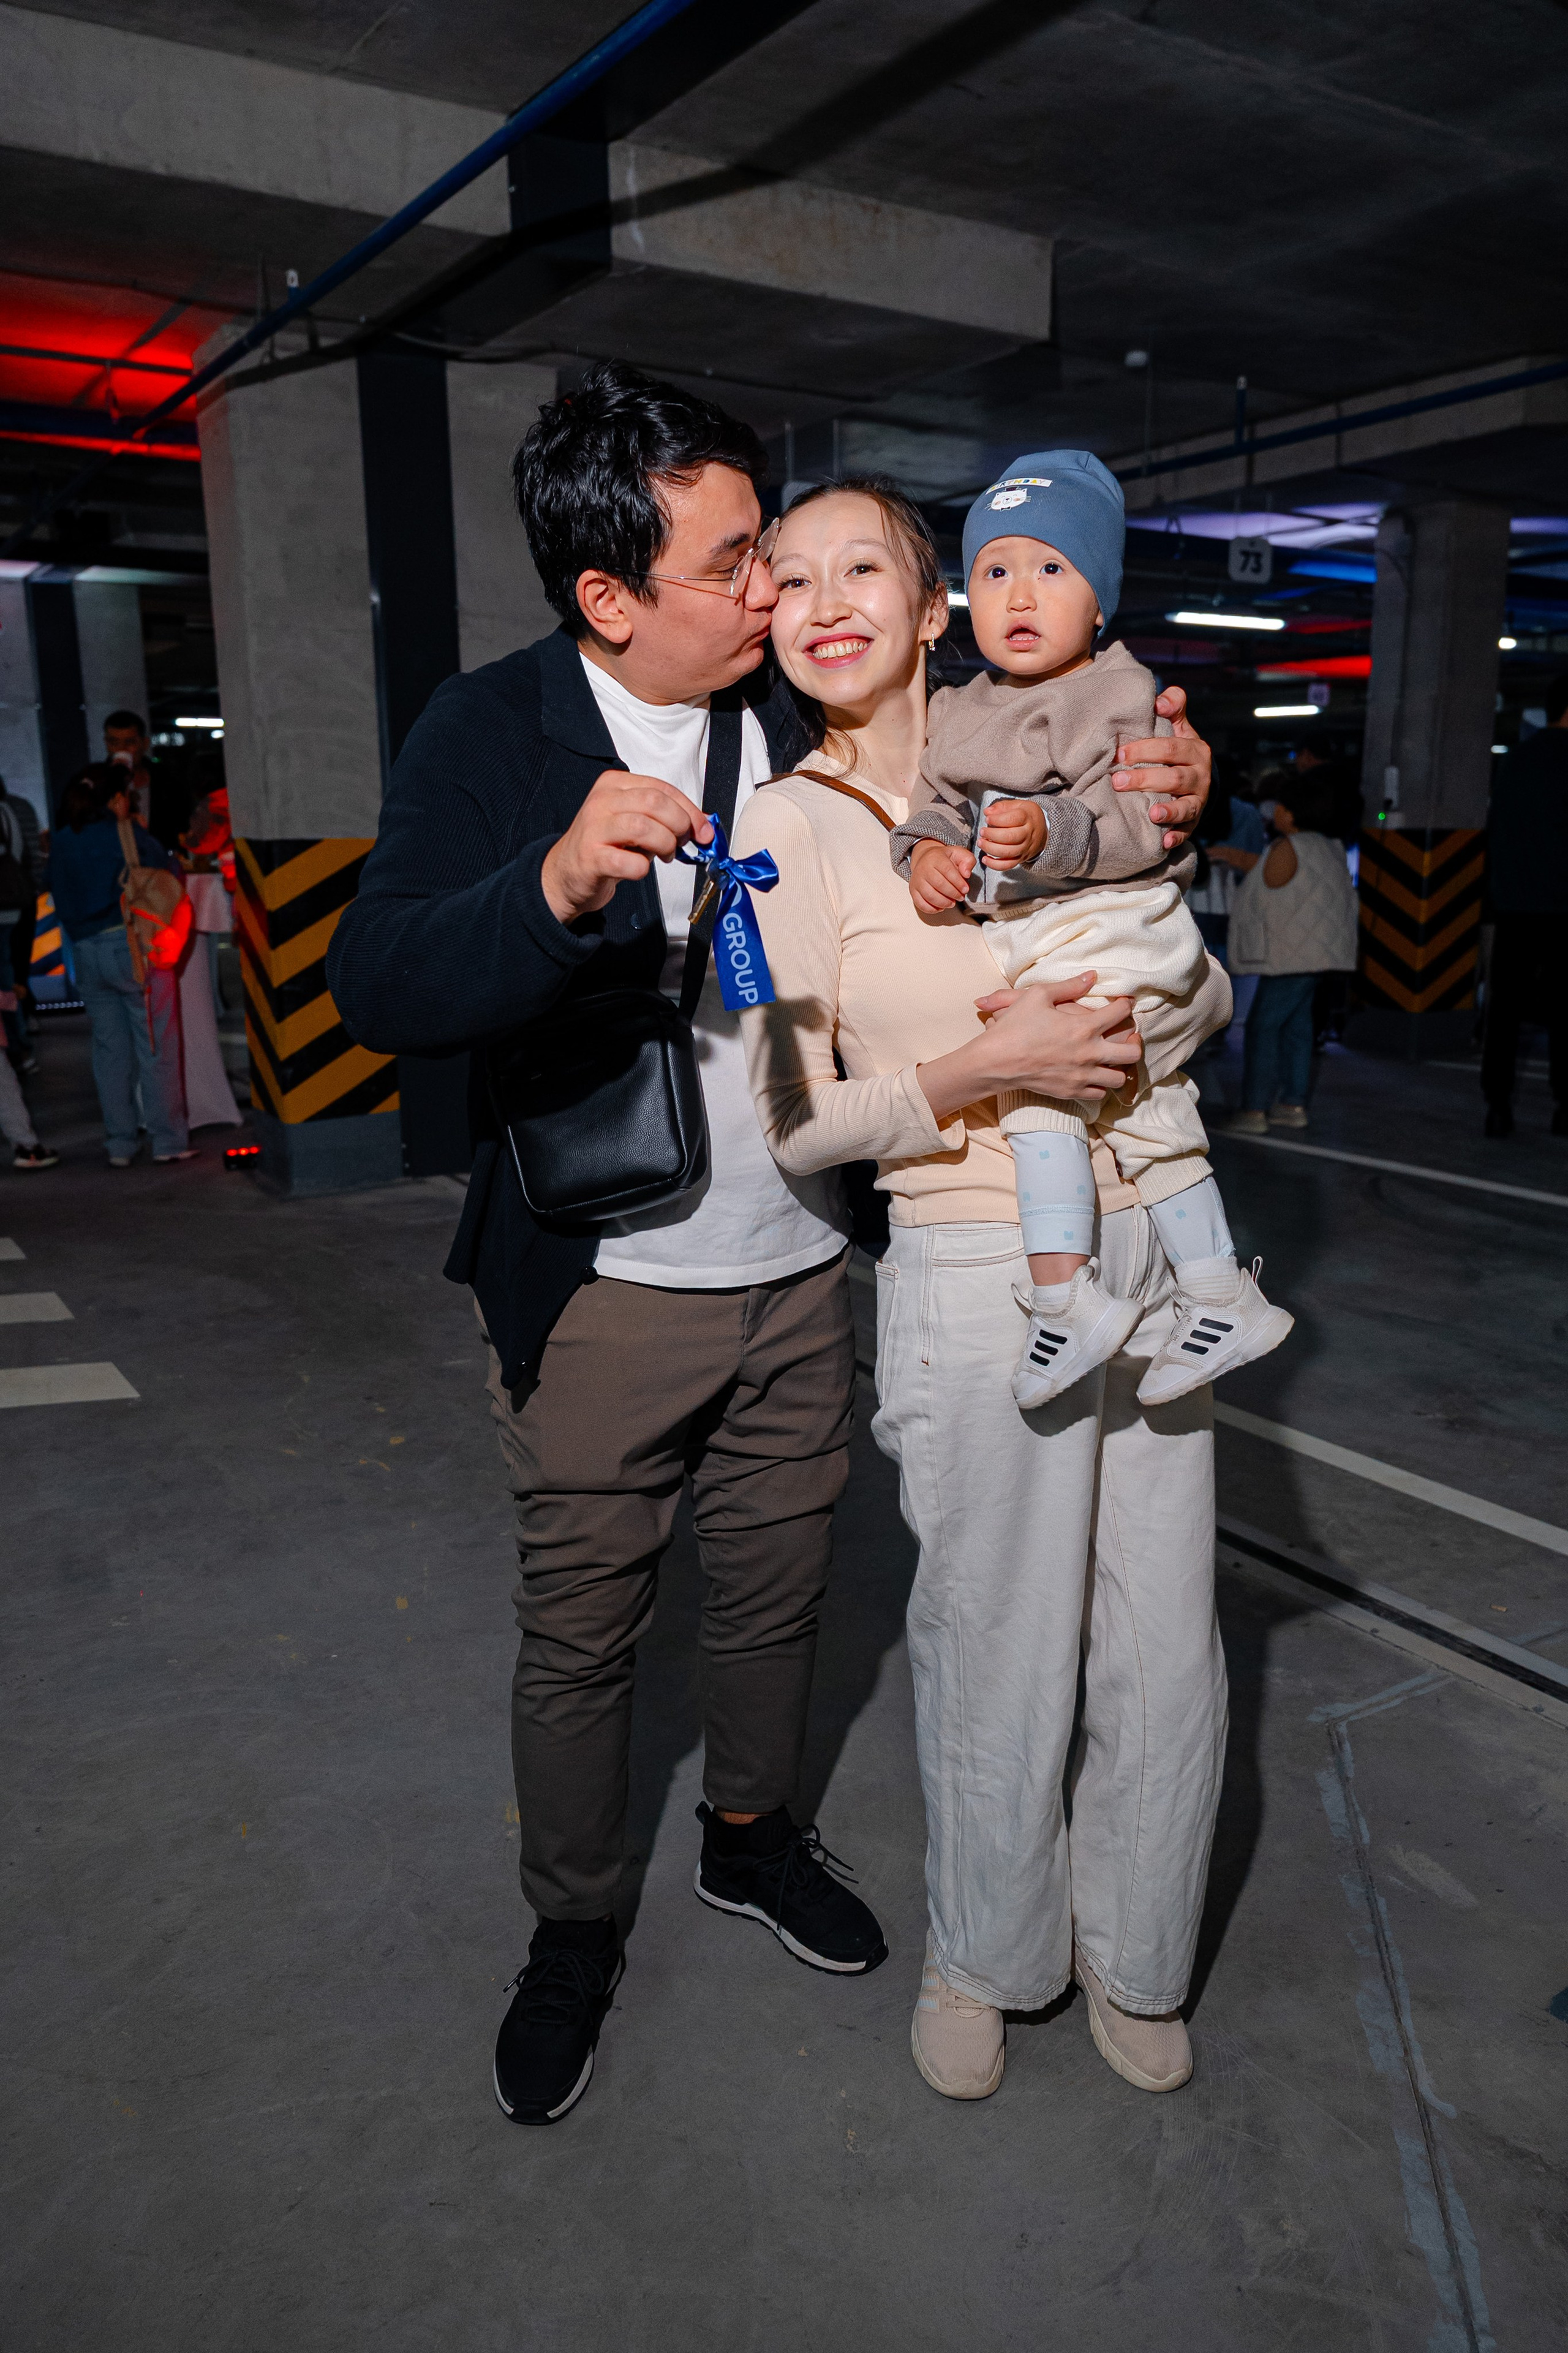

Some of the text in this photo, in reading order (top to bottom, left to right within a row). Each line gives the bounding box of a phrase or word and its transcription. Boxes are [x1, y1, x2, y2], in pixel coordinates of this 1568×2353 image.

[991, 479, 1044, 491] BIRTHDAY
[1240, 551, 1262, 573] 73
[722, 913, 759, 1004] GROUP
